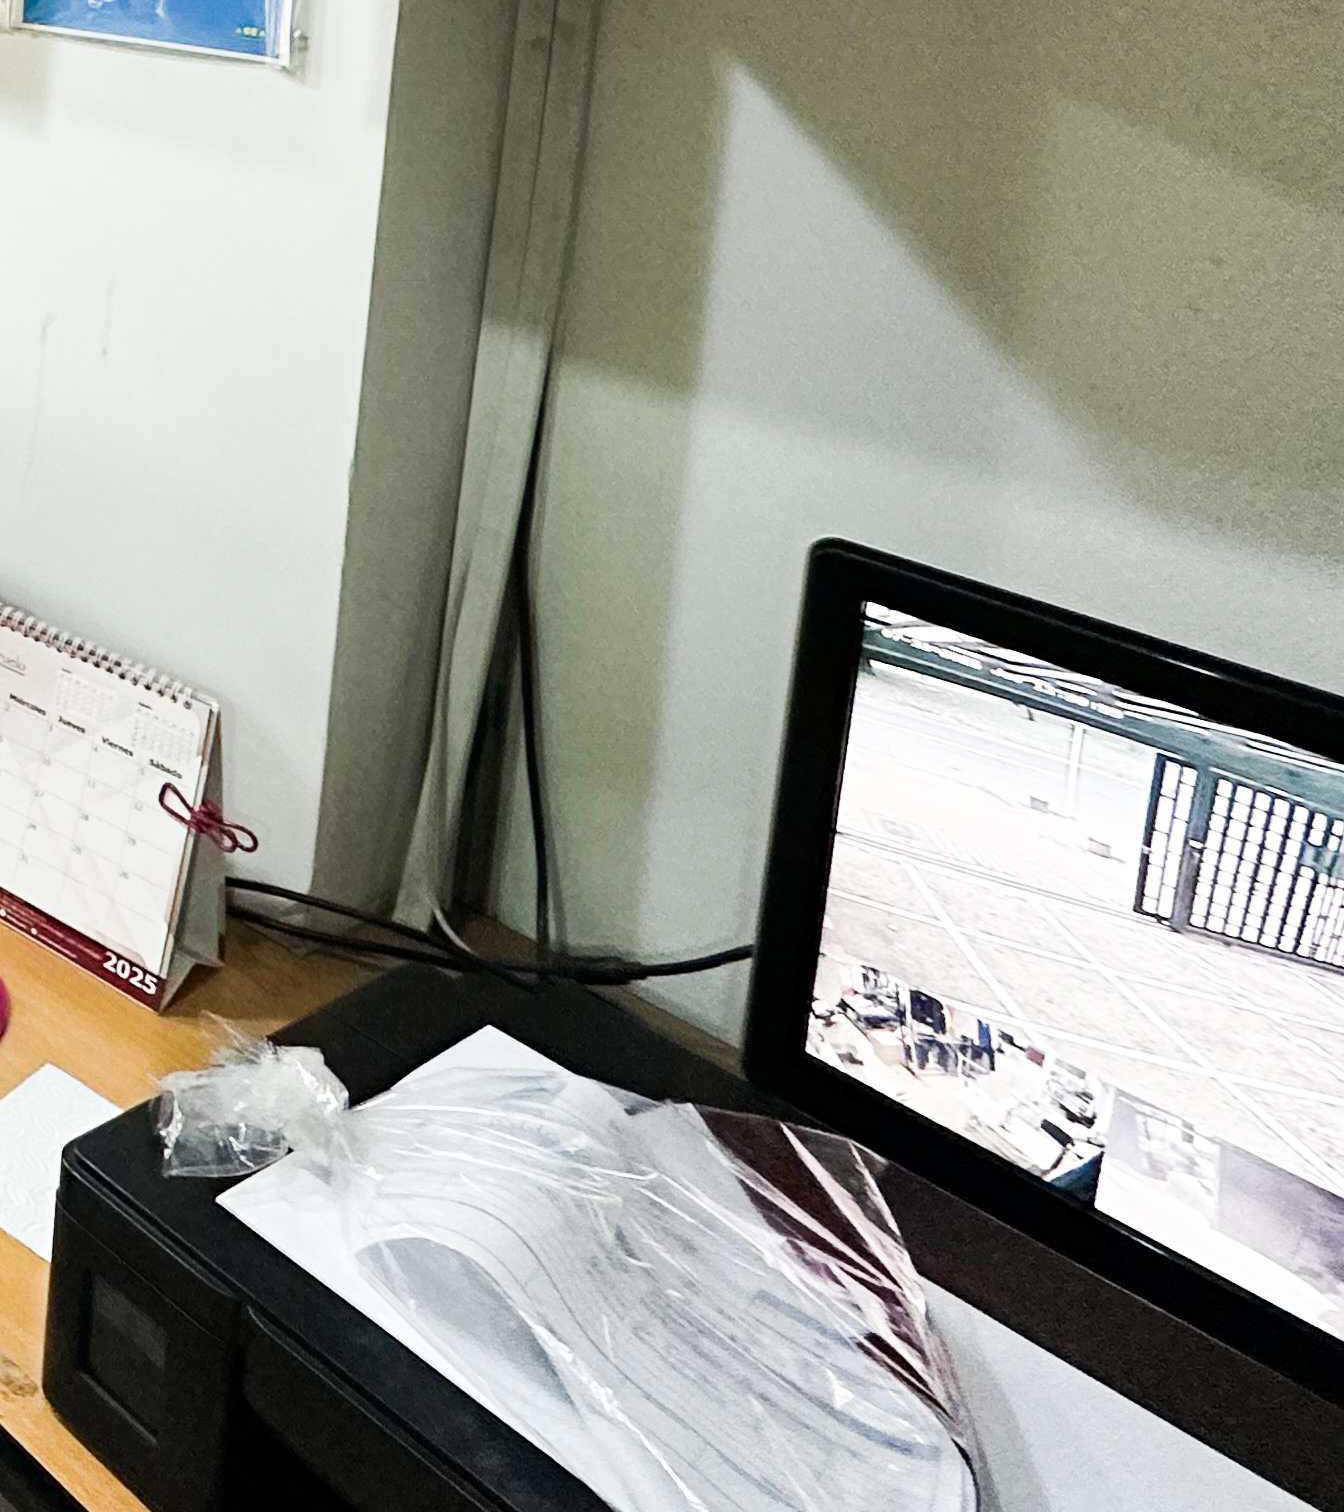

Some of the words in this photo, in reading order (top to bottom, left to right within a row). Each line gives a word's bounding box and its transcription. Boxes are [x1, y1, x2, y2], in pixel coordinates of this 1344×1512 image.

[59, 715, 86, 734] Jueves
[102, 735, 134, 757] Viernes
[103, 951, 158, 995] 2025
